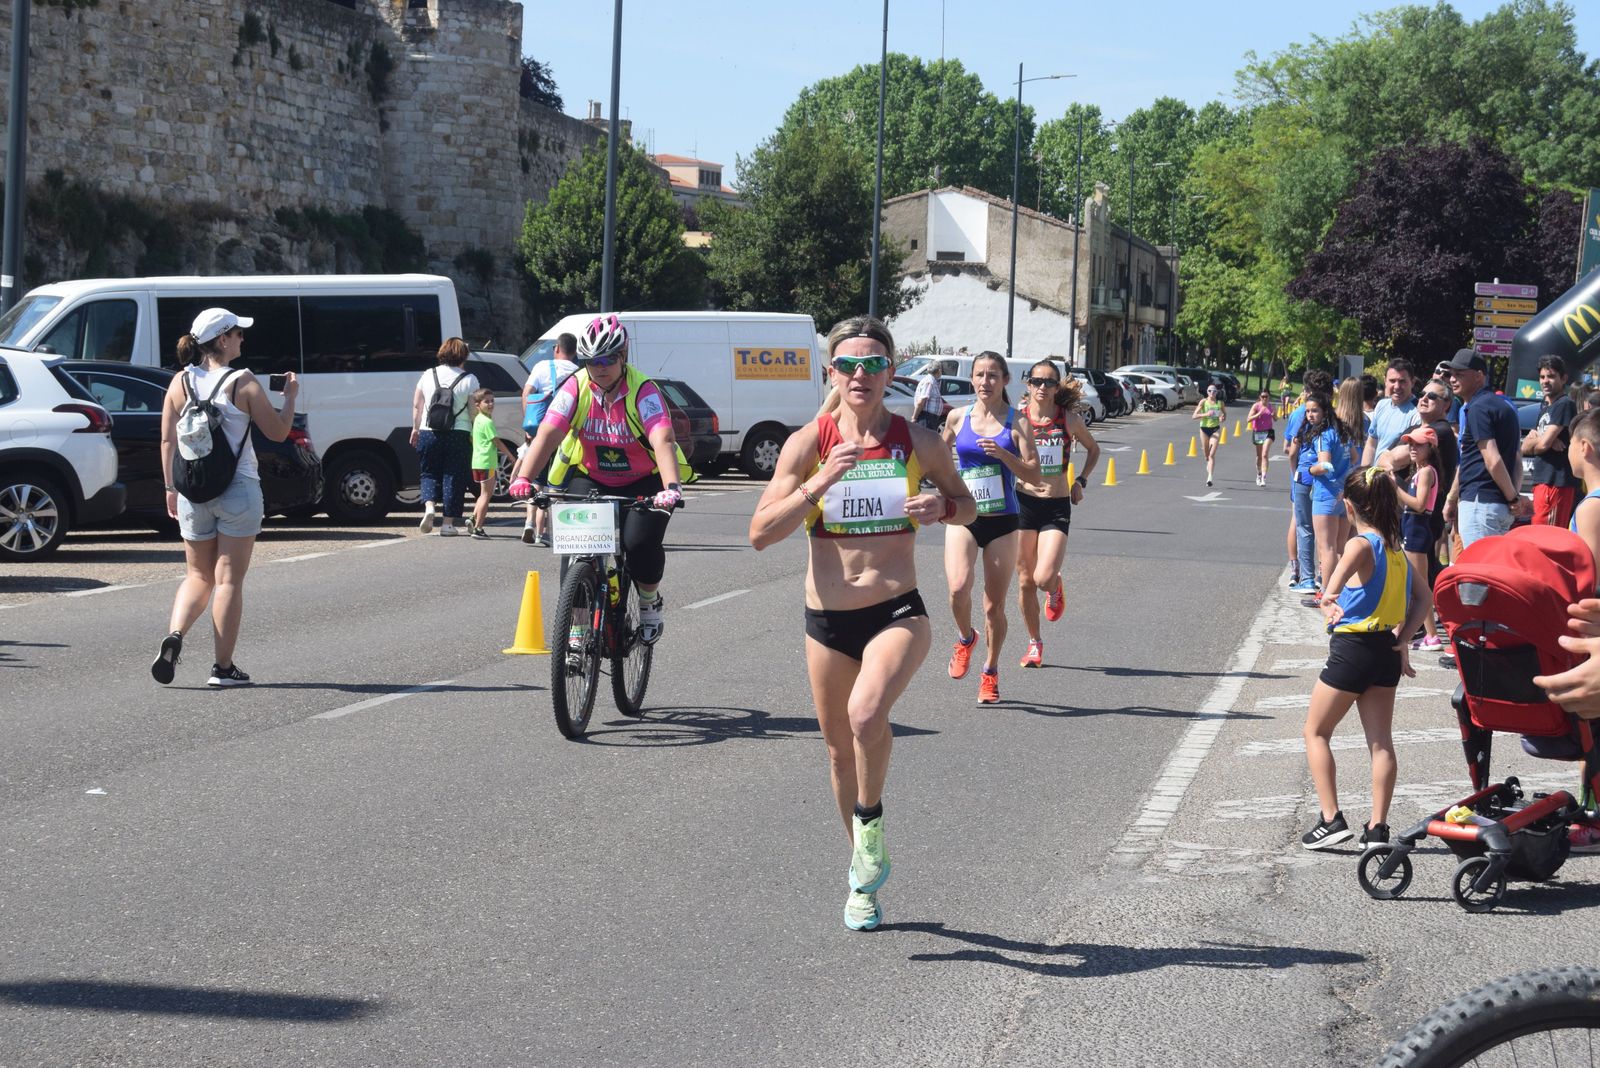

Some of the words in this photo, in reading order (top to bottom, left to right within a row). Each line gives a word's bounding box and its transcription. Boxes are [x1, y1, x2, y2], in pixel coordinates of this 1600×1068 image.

[1034, 437, 1064, 447] ENYA
[1040, 455, 1054, 465] RTA
[854, 462, 896, 471] NDACION
[846, 471, 867, 479] CAJA
[868, 469, 896, 478] RURAL
[844, 486, 851, 497] 11
[971, 486, 991, 500] ARÍA
[842, 497, 884, 518] ELENA
[848, 526, 871, 535] CAJA
[874, 523, 904, 533] RURAL
[554, 533, 613, 542] ORGANIZACIÓN
